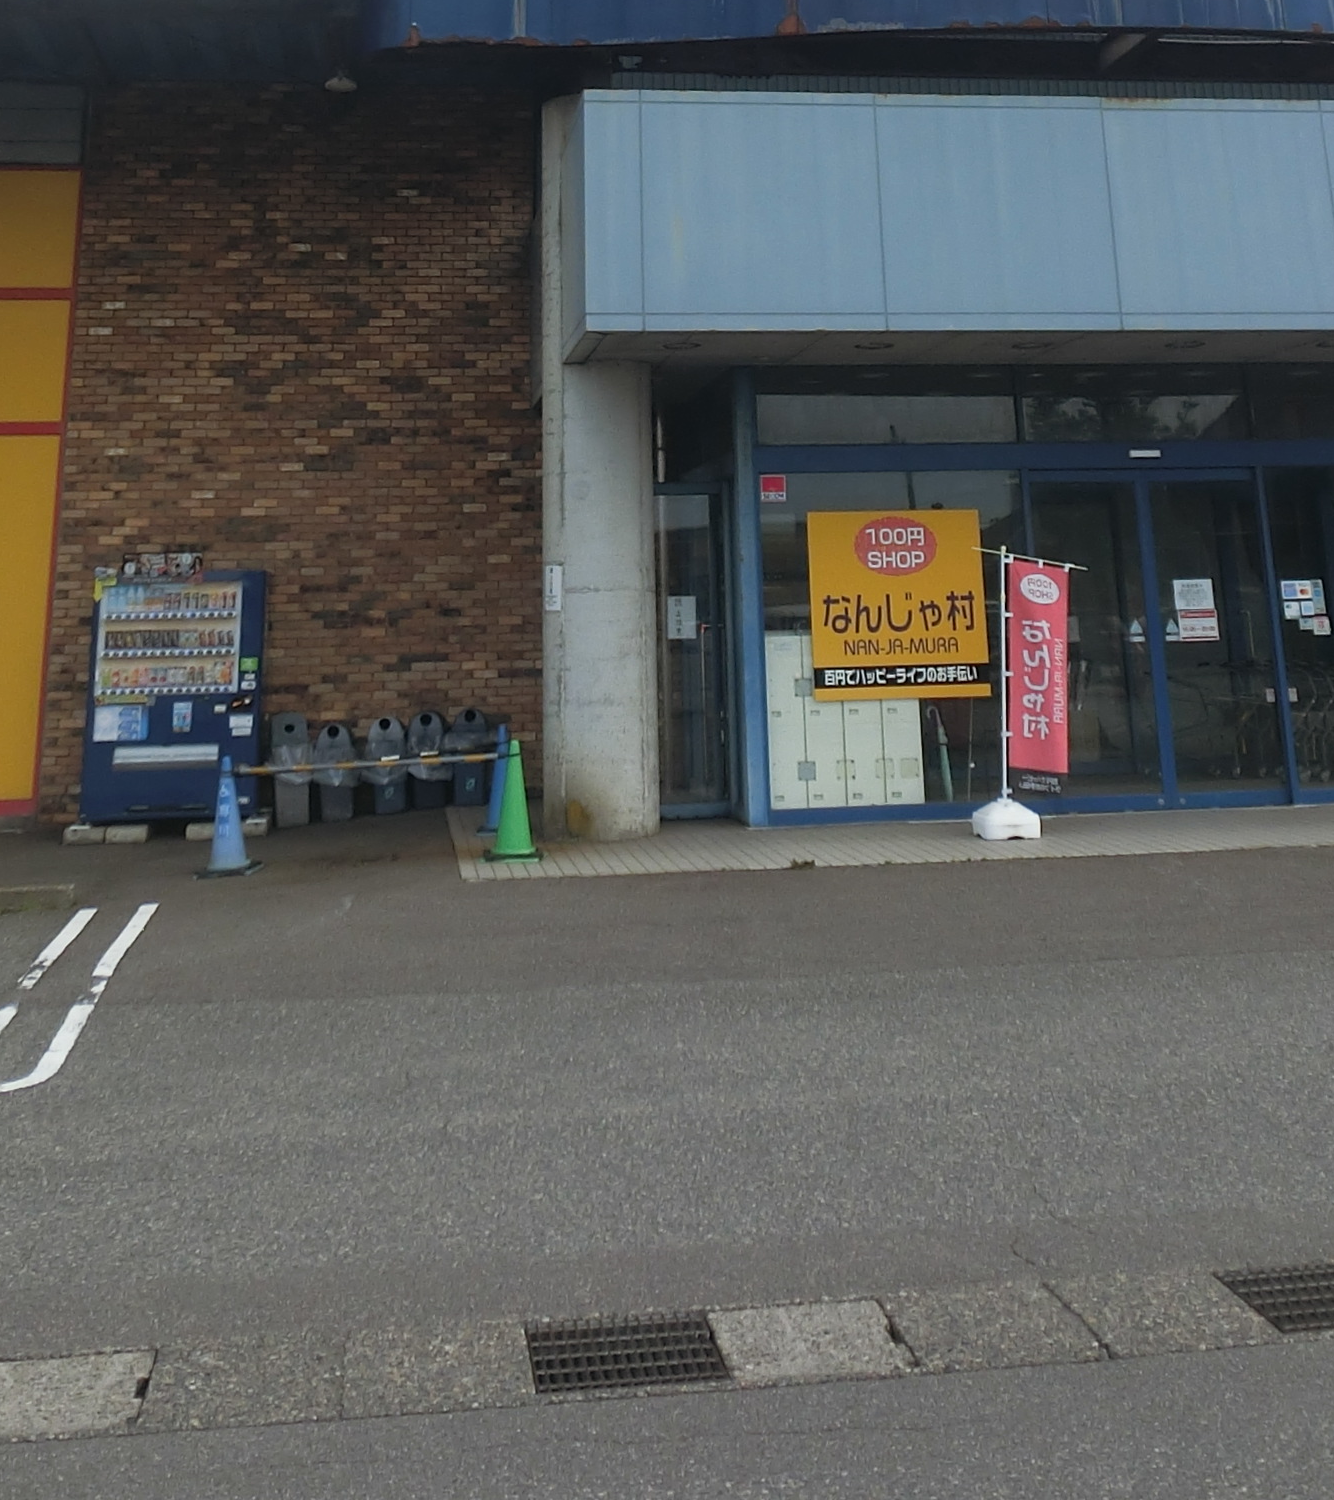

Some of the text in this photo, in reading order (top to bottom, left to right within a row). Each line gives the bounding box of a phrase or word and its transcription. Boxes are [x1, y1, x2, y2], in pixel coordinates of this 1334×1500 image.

[865, 527, 925, 546] 100円
[867, 551, 925, 569] SHOP
[822, 590, 975, 634] なんじゃ村
[843, 636, 959, 656] NAN-JA-MURA
[824, 665, 978, 687] 百円でハッピーライフのお手伝い
